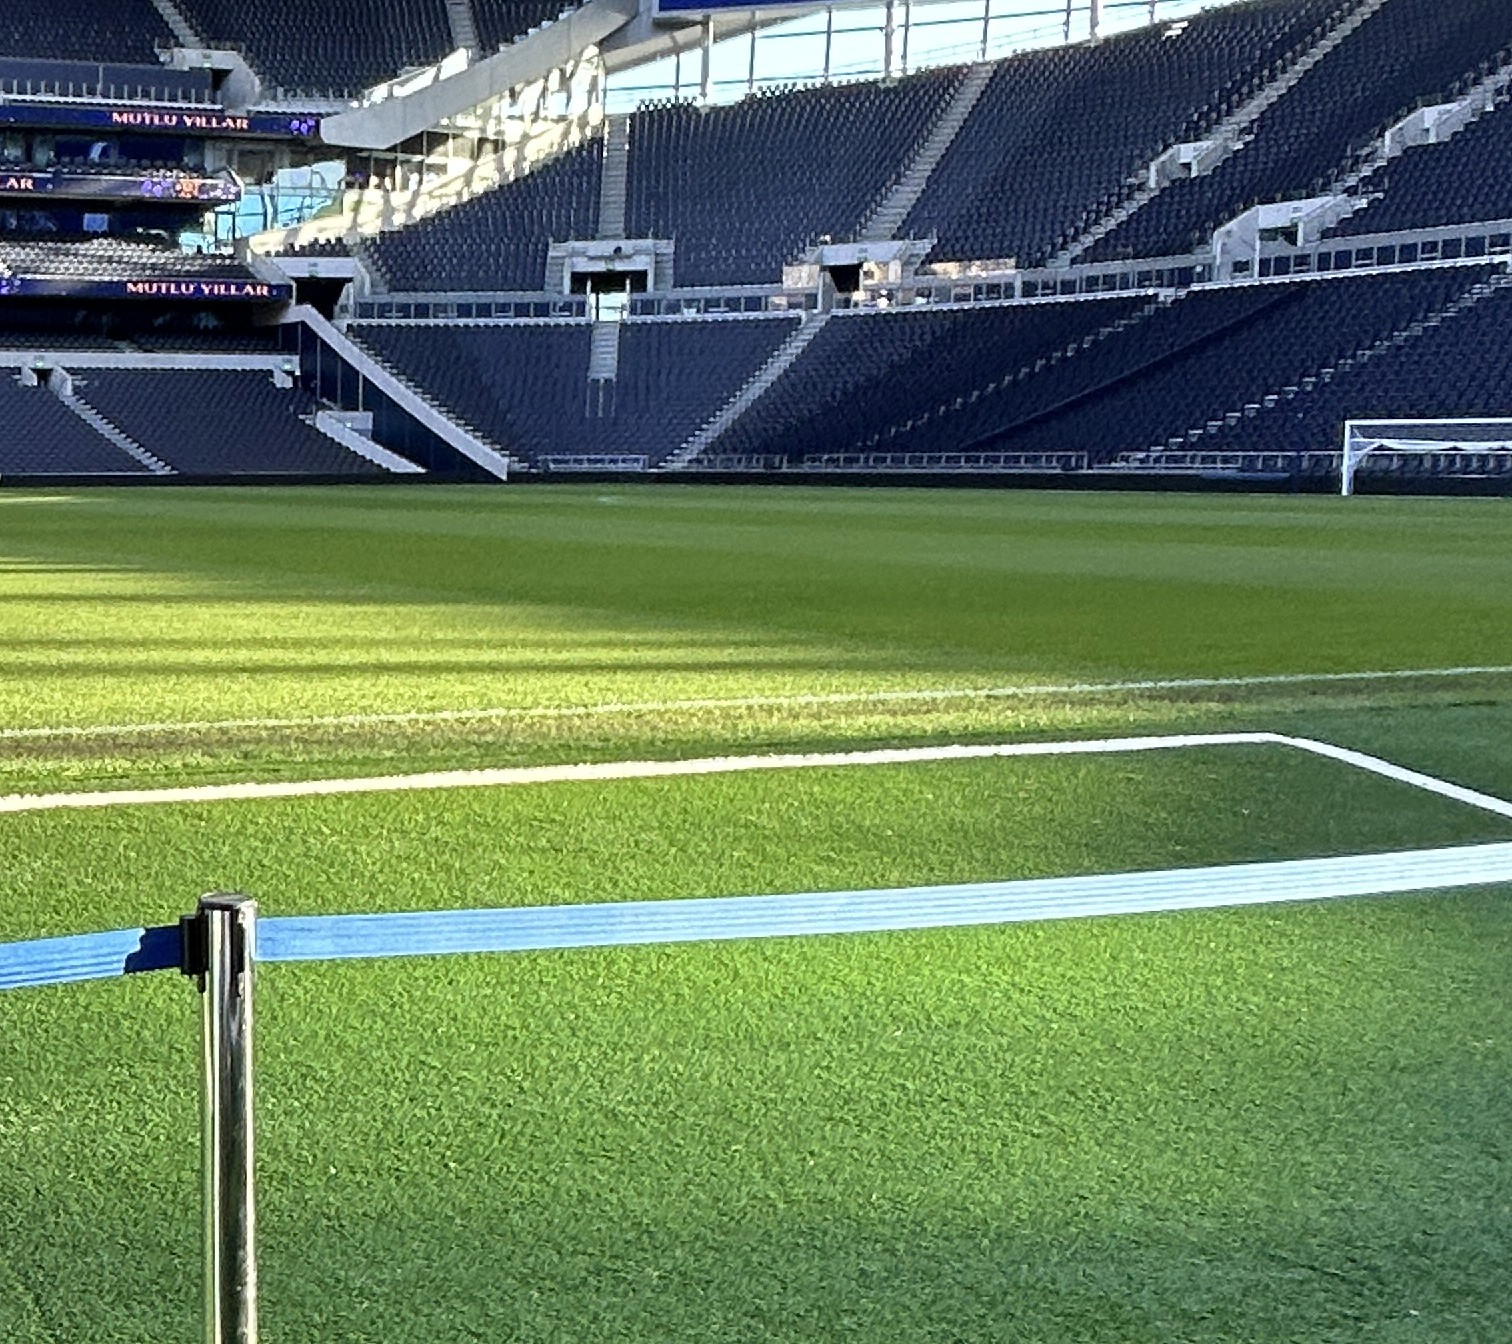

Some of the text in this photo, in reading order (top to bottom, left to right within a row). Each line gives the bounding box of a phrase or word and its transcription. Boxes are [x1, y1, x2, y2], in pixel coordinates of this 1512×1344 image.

[112, 112, 249, 130] MUTLU YILLAR
[126, 282, 270, 297] MUTLU YILLAR
